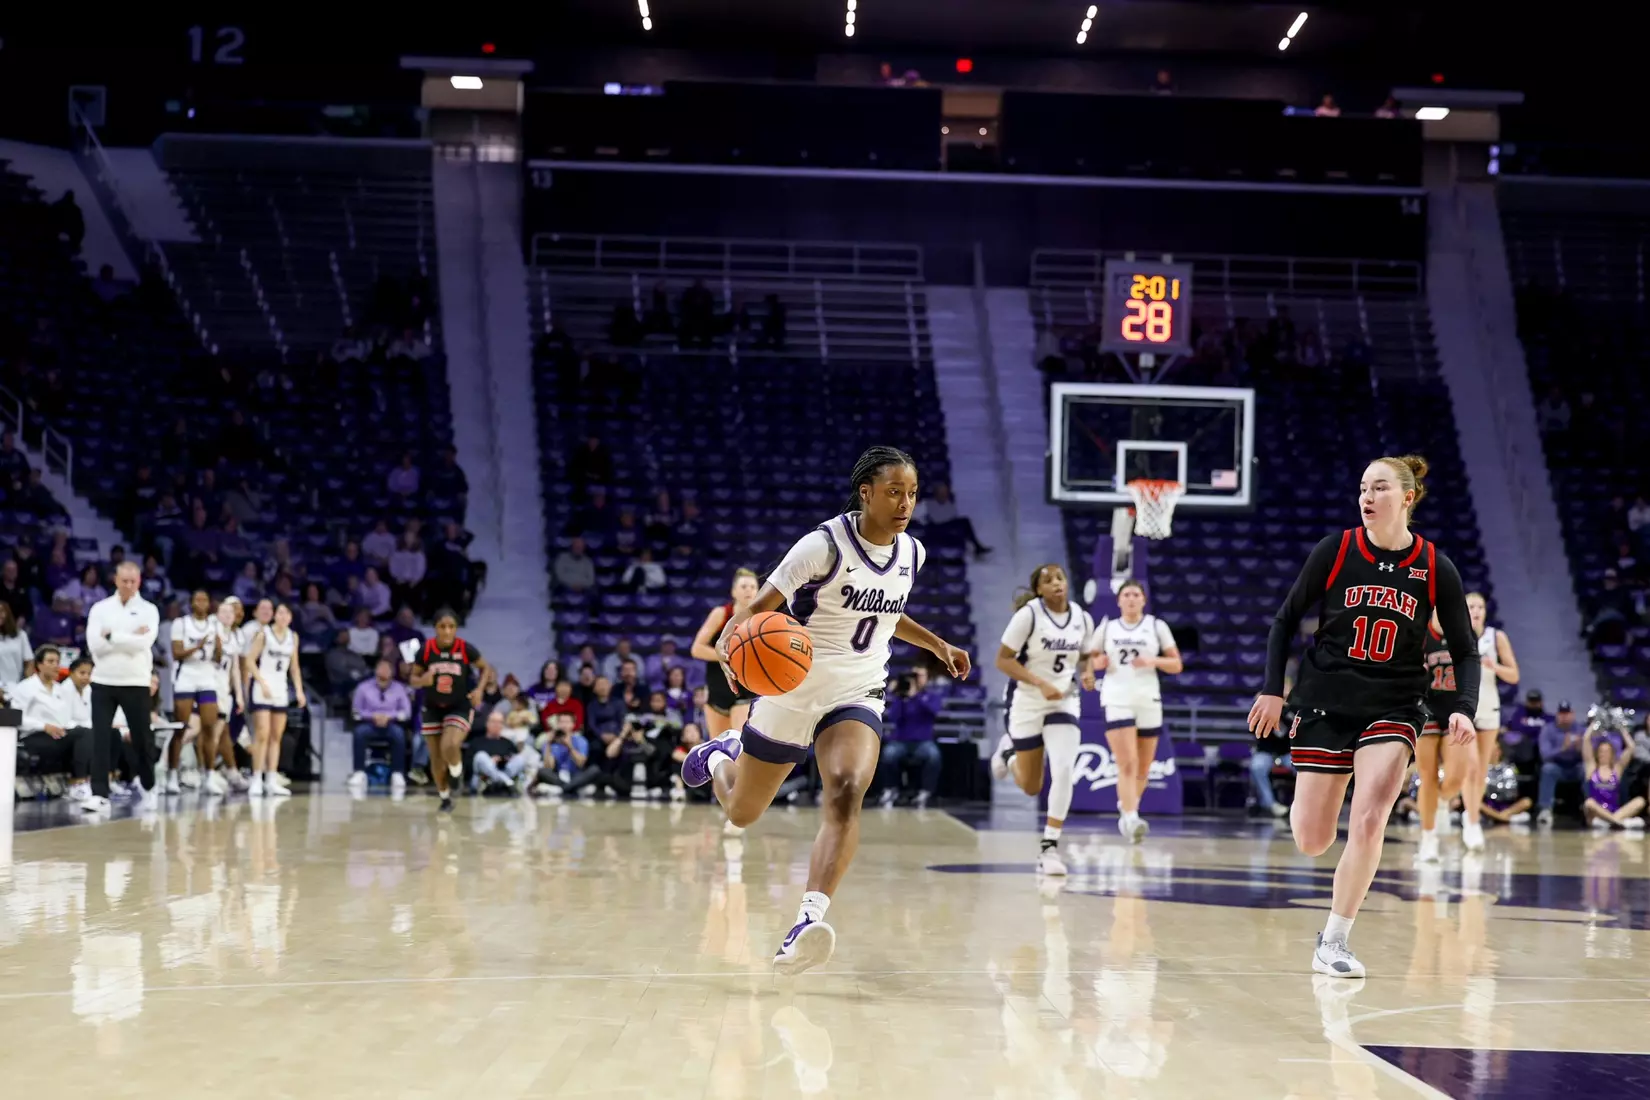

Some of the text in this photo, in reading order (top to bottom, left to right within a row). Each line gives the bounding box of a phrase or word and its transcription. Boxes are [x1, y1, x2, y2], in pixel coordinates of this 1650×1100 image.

[187, 23, 246, 65] 12
[1130, 274, 1180, 301] 2:01
[1121, 299, 1172, 342] 28
[841, 584, 905, 614] Wildcat
[1344, 585, 1418, 620] UTAH
[849, 614, 879, 653] 0
[1348, 616, 1398, 662] 10
[1052, 654, 1067, 673] 5
